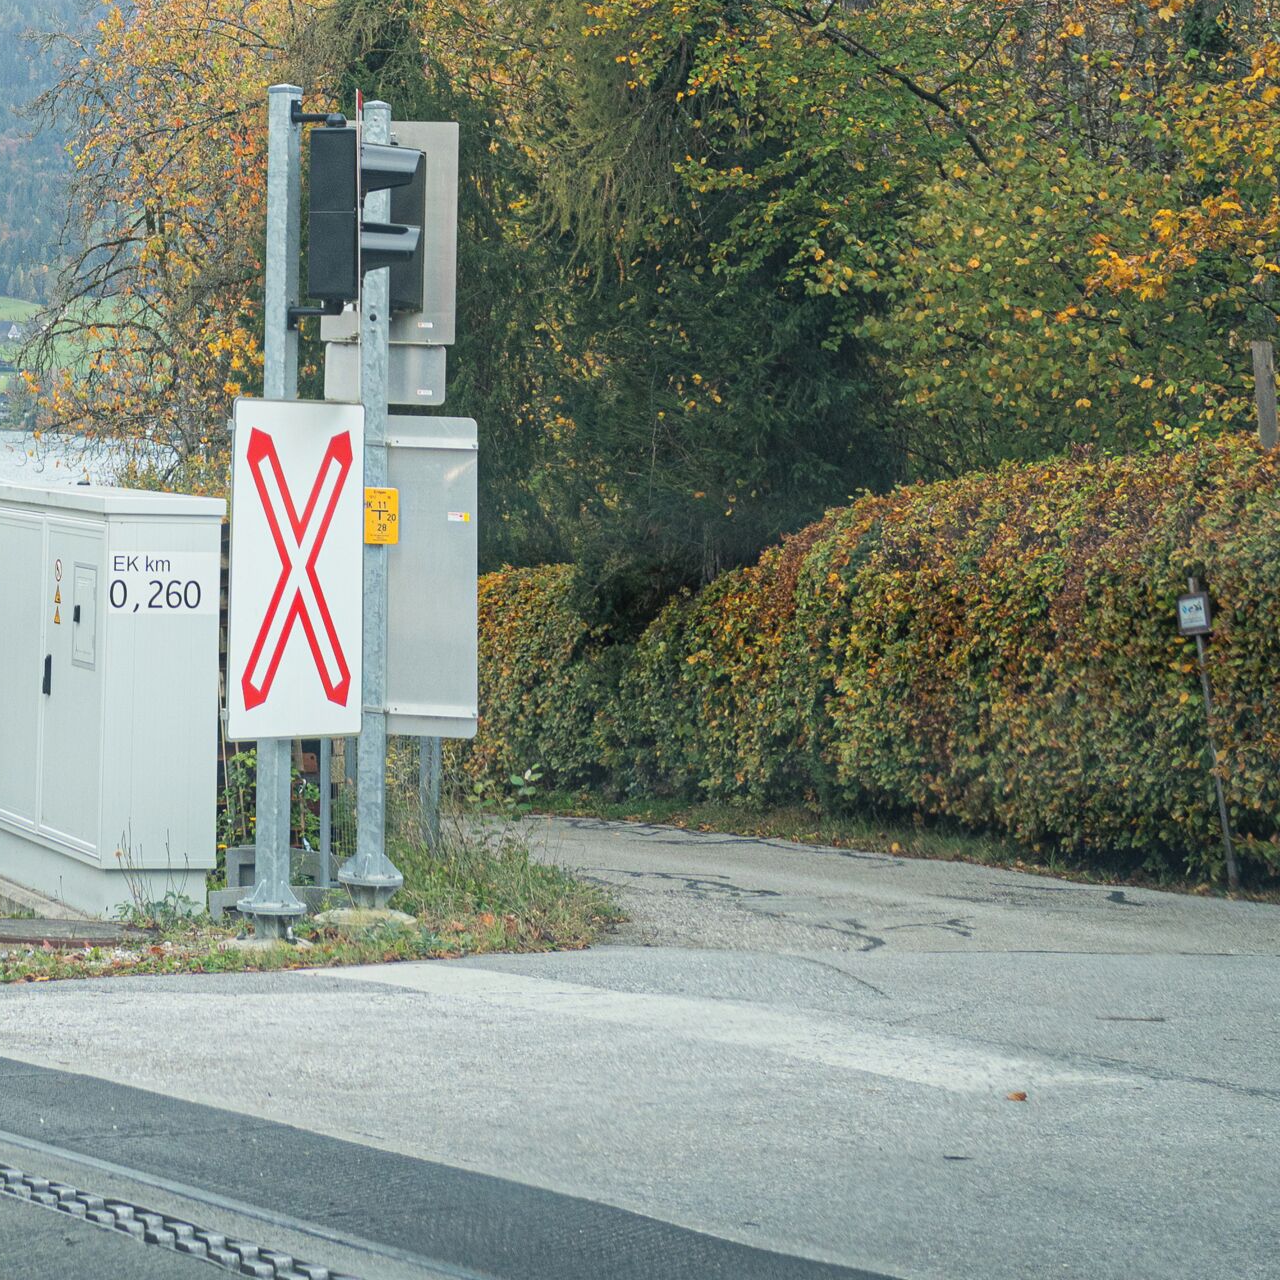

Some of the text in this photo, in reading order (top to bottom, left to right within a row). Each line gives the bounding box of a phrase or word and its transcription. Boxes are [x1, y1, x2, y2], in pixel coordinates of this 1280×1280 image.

[378, 500, 386, 509] 11
[113, 555, 171, 572] EK km
[109, 579, 202, 613] 0,260
